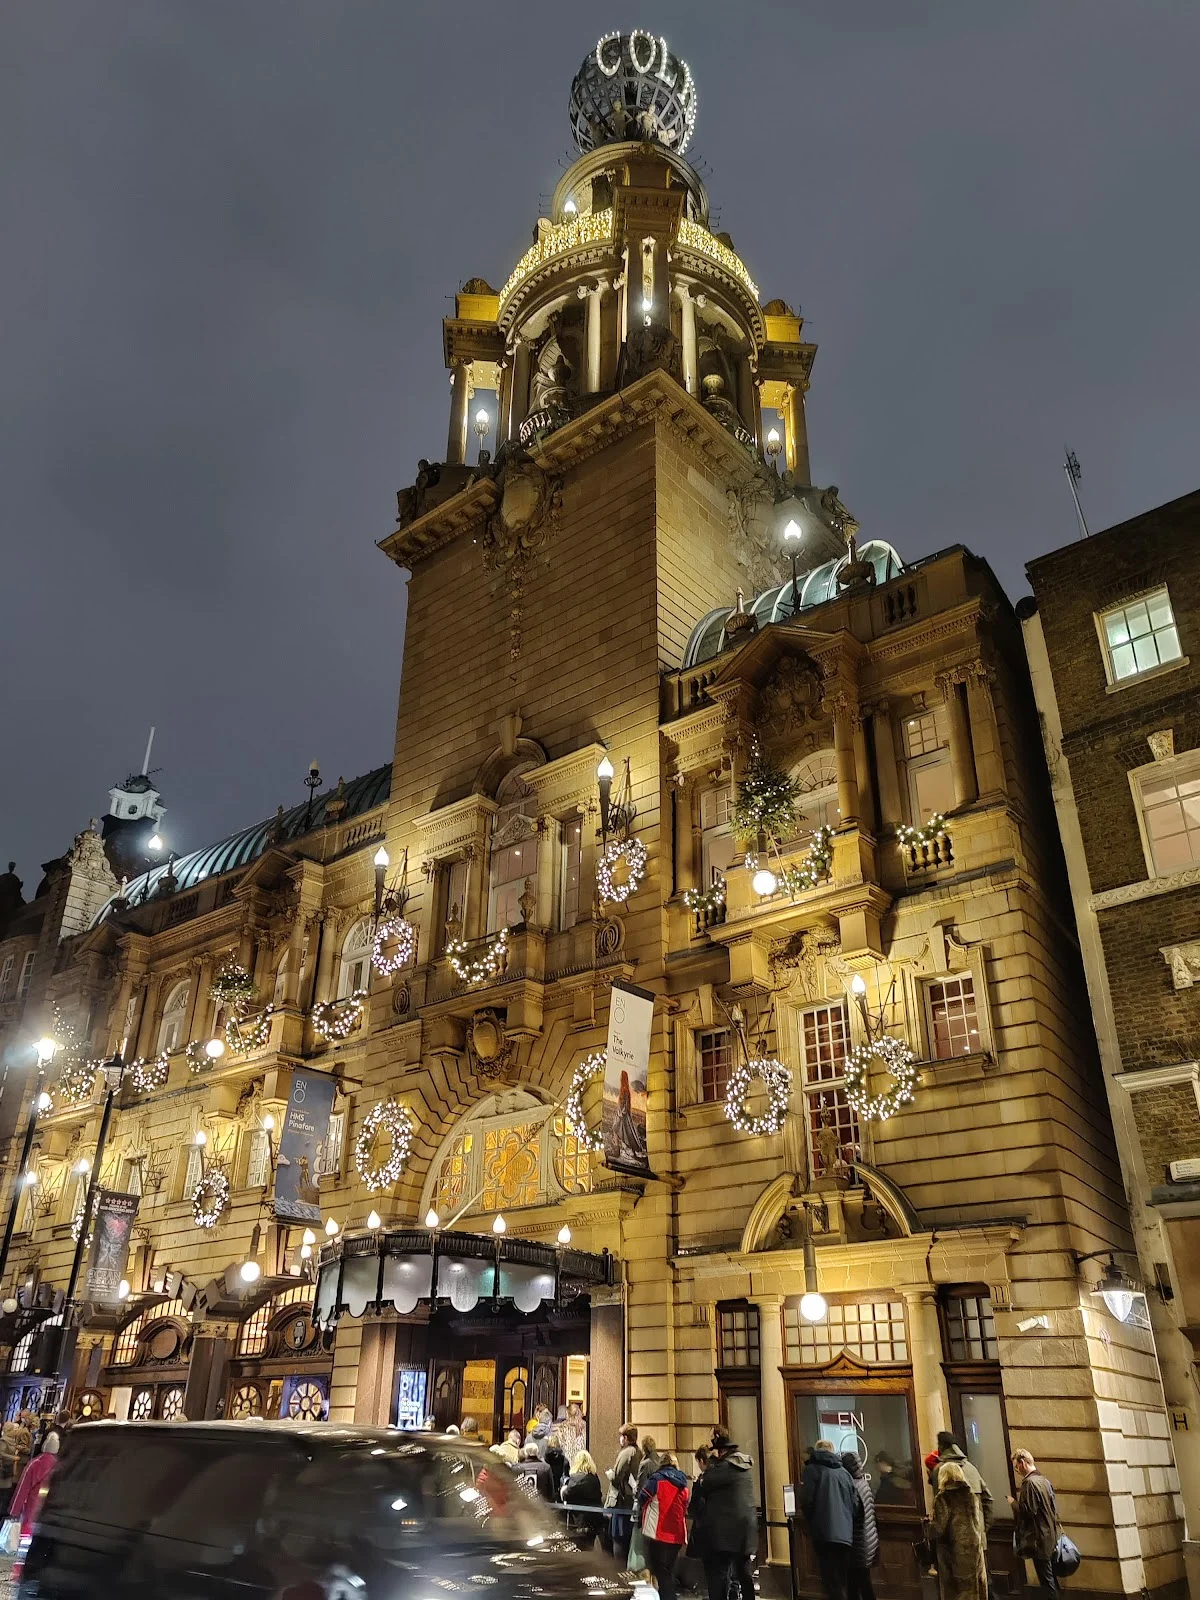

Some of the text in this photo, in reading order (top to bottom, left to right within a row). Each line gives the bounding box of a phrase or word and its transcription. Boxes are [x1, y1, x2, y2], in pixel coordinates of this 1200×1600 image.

[615, 996, 626, 1008] EN
[612, 1034, 624, 1046] The
[612, 1045, 635, 1061] Valkyrie
[295, 1079, 307, 1090] EN
[289, 1111, 305, 1122] HMS
[288, 1120, 315, 1132] Pinafore
[837, 1411, 865, 1432] EN
[1172, 1412, 1189, 1431] H
